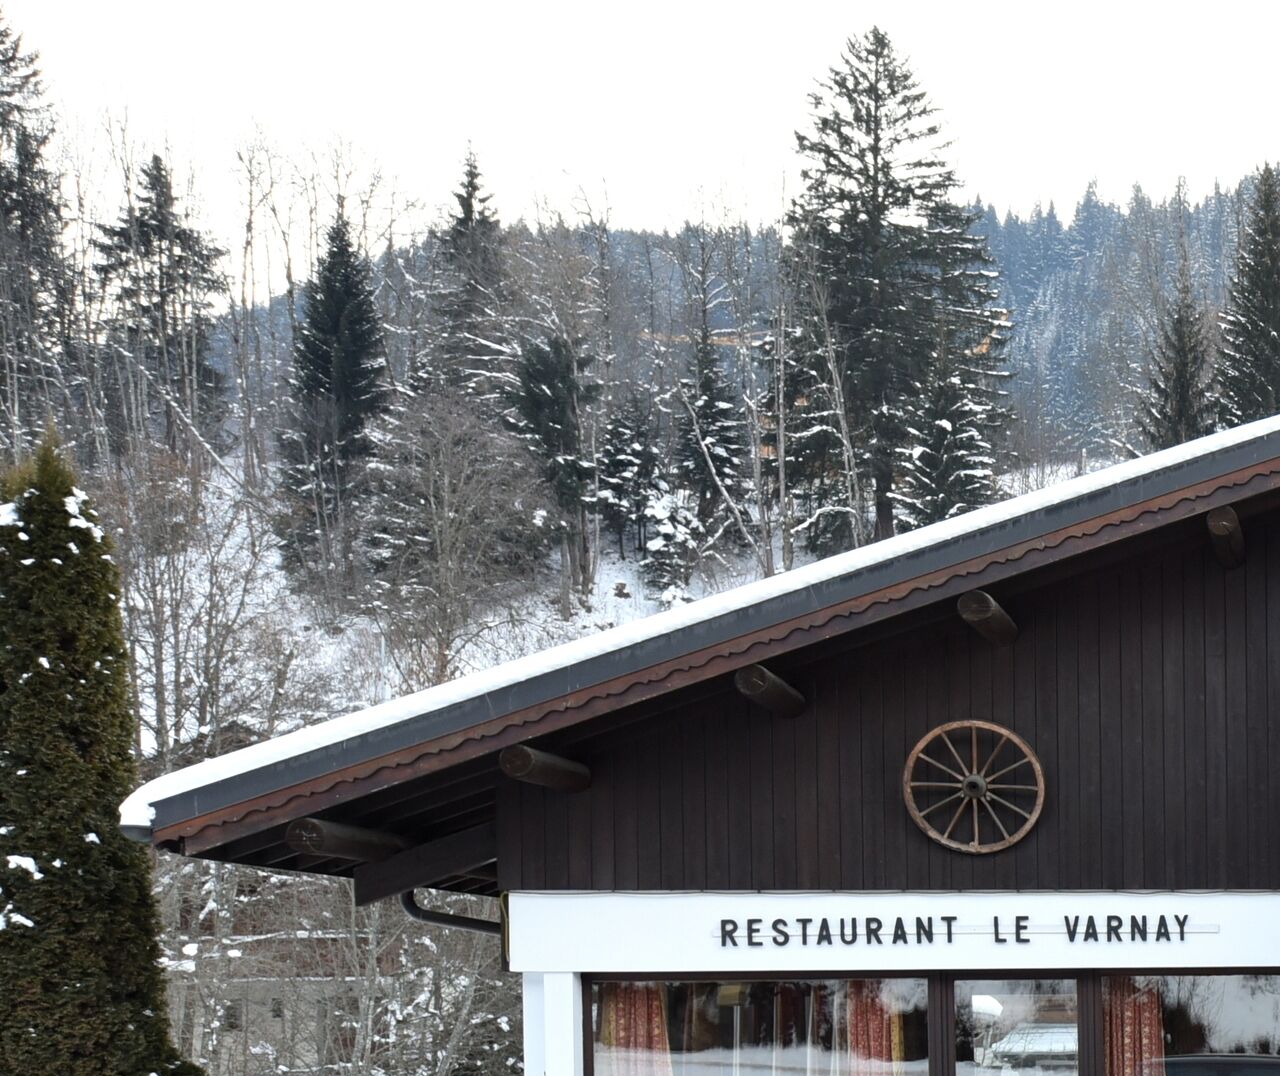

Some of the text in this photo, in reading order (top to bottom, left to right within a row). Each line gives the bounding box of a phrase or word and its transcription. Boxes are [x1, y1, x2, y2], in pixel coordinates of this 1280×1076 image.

[719, 914, 1189, 947] RESTAURANT LE VARNAY
